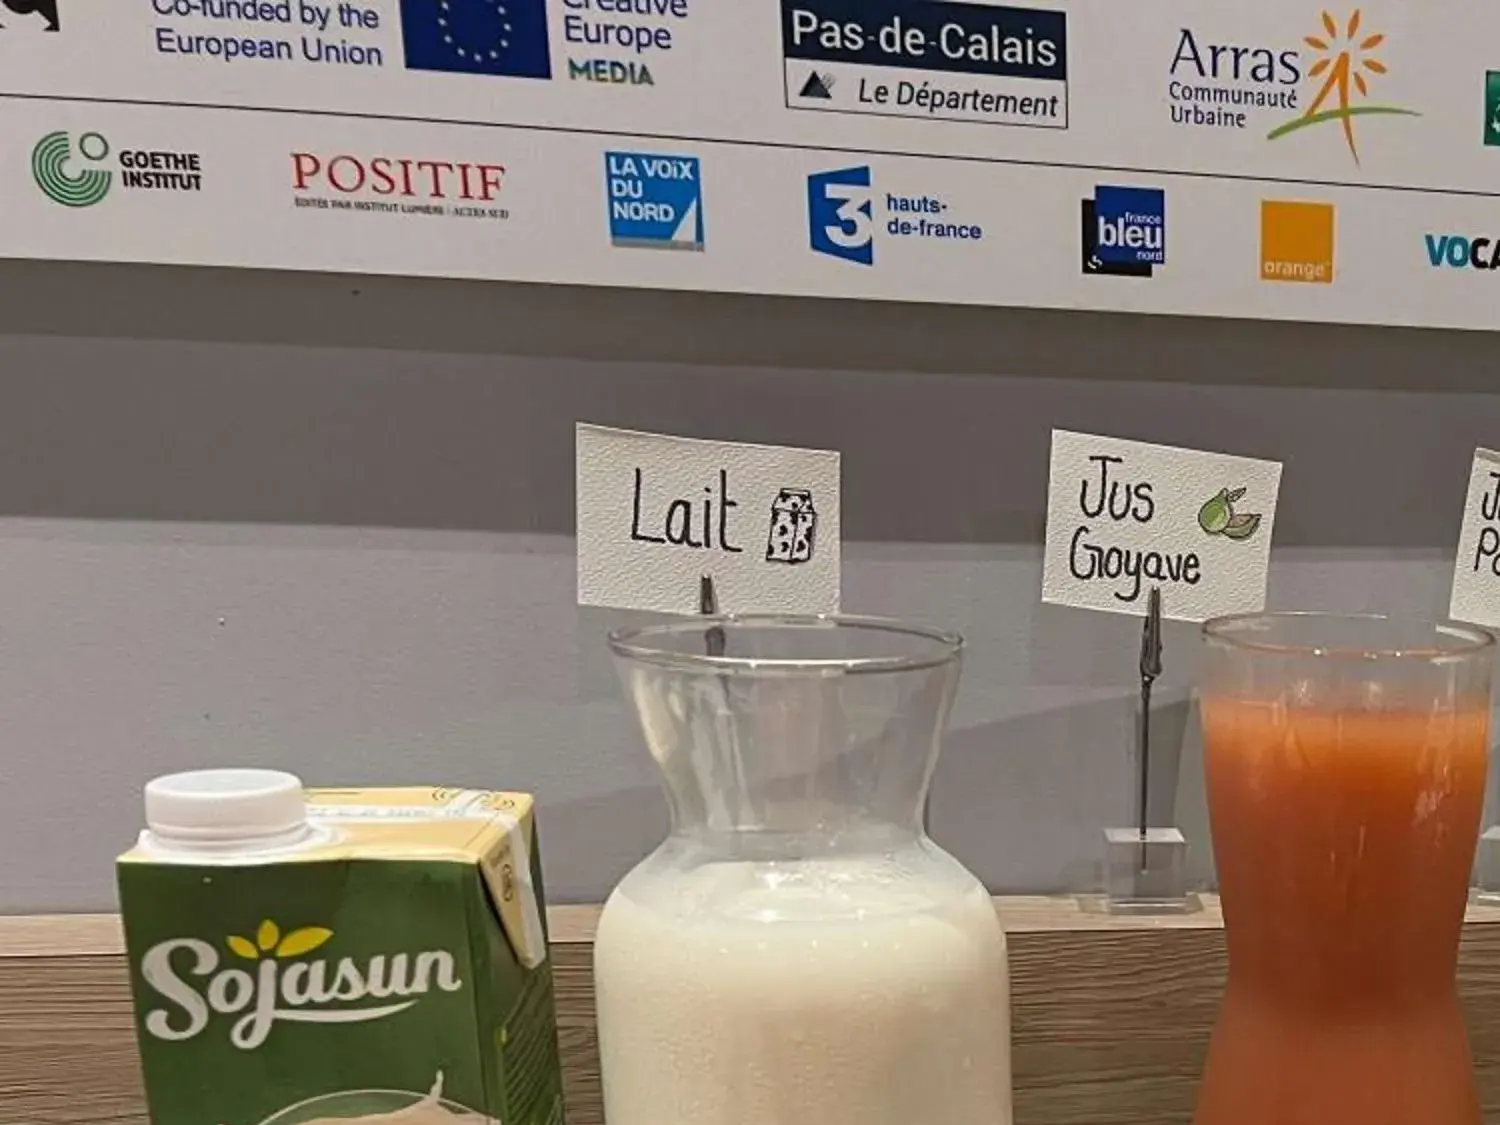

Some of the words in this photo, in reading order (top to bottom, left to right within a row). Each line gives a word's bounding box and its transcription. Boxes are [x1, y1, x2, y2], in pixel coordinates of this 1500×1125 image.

[300, 0, 330, 31] by
[338, 3, 380, 29] the
[155, 28, 293, 61] European
[301, 37, 384, 66] Union
[564, 15, 672, 53] Europe
[791, 9, 1057, 67] Pas-de-Calais
[568, 57, 655, 86] MEDIA
[1169, 28, 1301, 85] Arras
[859, 78, 889, 104] Le
[897, 81, 1059, 117] Département
[1169, 80, 1298, 109] Communauté
[1170, 105, 1247, 129] Urbaine
[119, 150, 202, 171] GOETHE
[609, 156, 639, 177] LA
[122, 169, 202, 191] INSTITUT
[289, 153, 506, 202] POSITIF
[611, 178, 643, 199] DU
[613, 201, 675, 222] NORD
[825, 183, 872, 248] 3
[886, 193, 948, 213] hauts-
[1125, 211, 1162, 225] france
[887, 217, 983, 239] de-france
[1098, 215, 1162, 249] bleu
[1136, 250, 1163, 261] nord
[1264, 261, 1325, 281] orange
[1080, 455, 1156, 524] Jus
[630, 468, 743, 552] Lait
[1069, 527, 1201, 601] Goyave
[141, 937, 462, 1050] Sojasun
